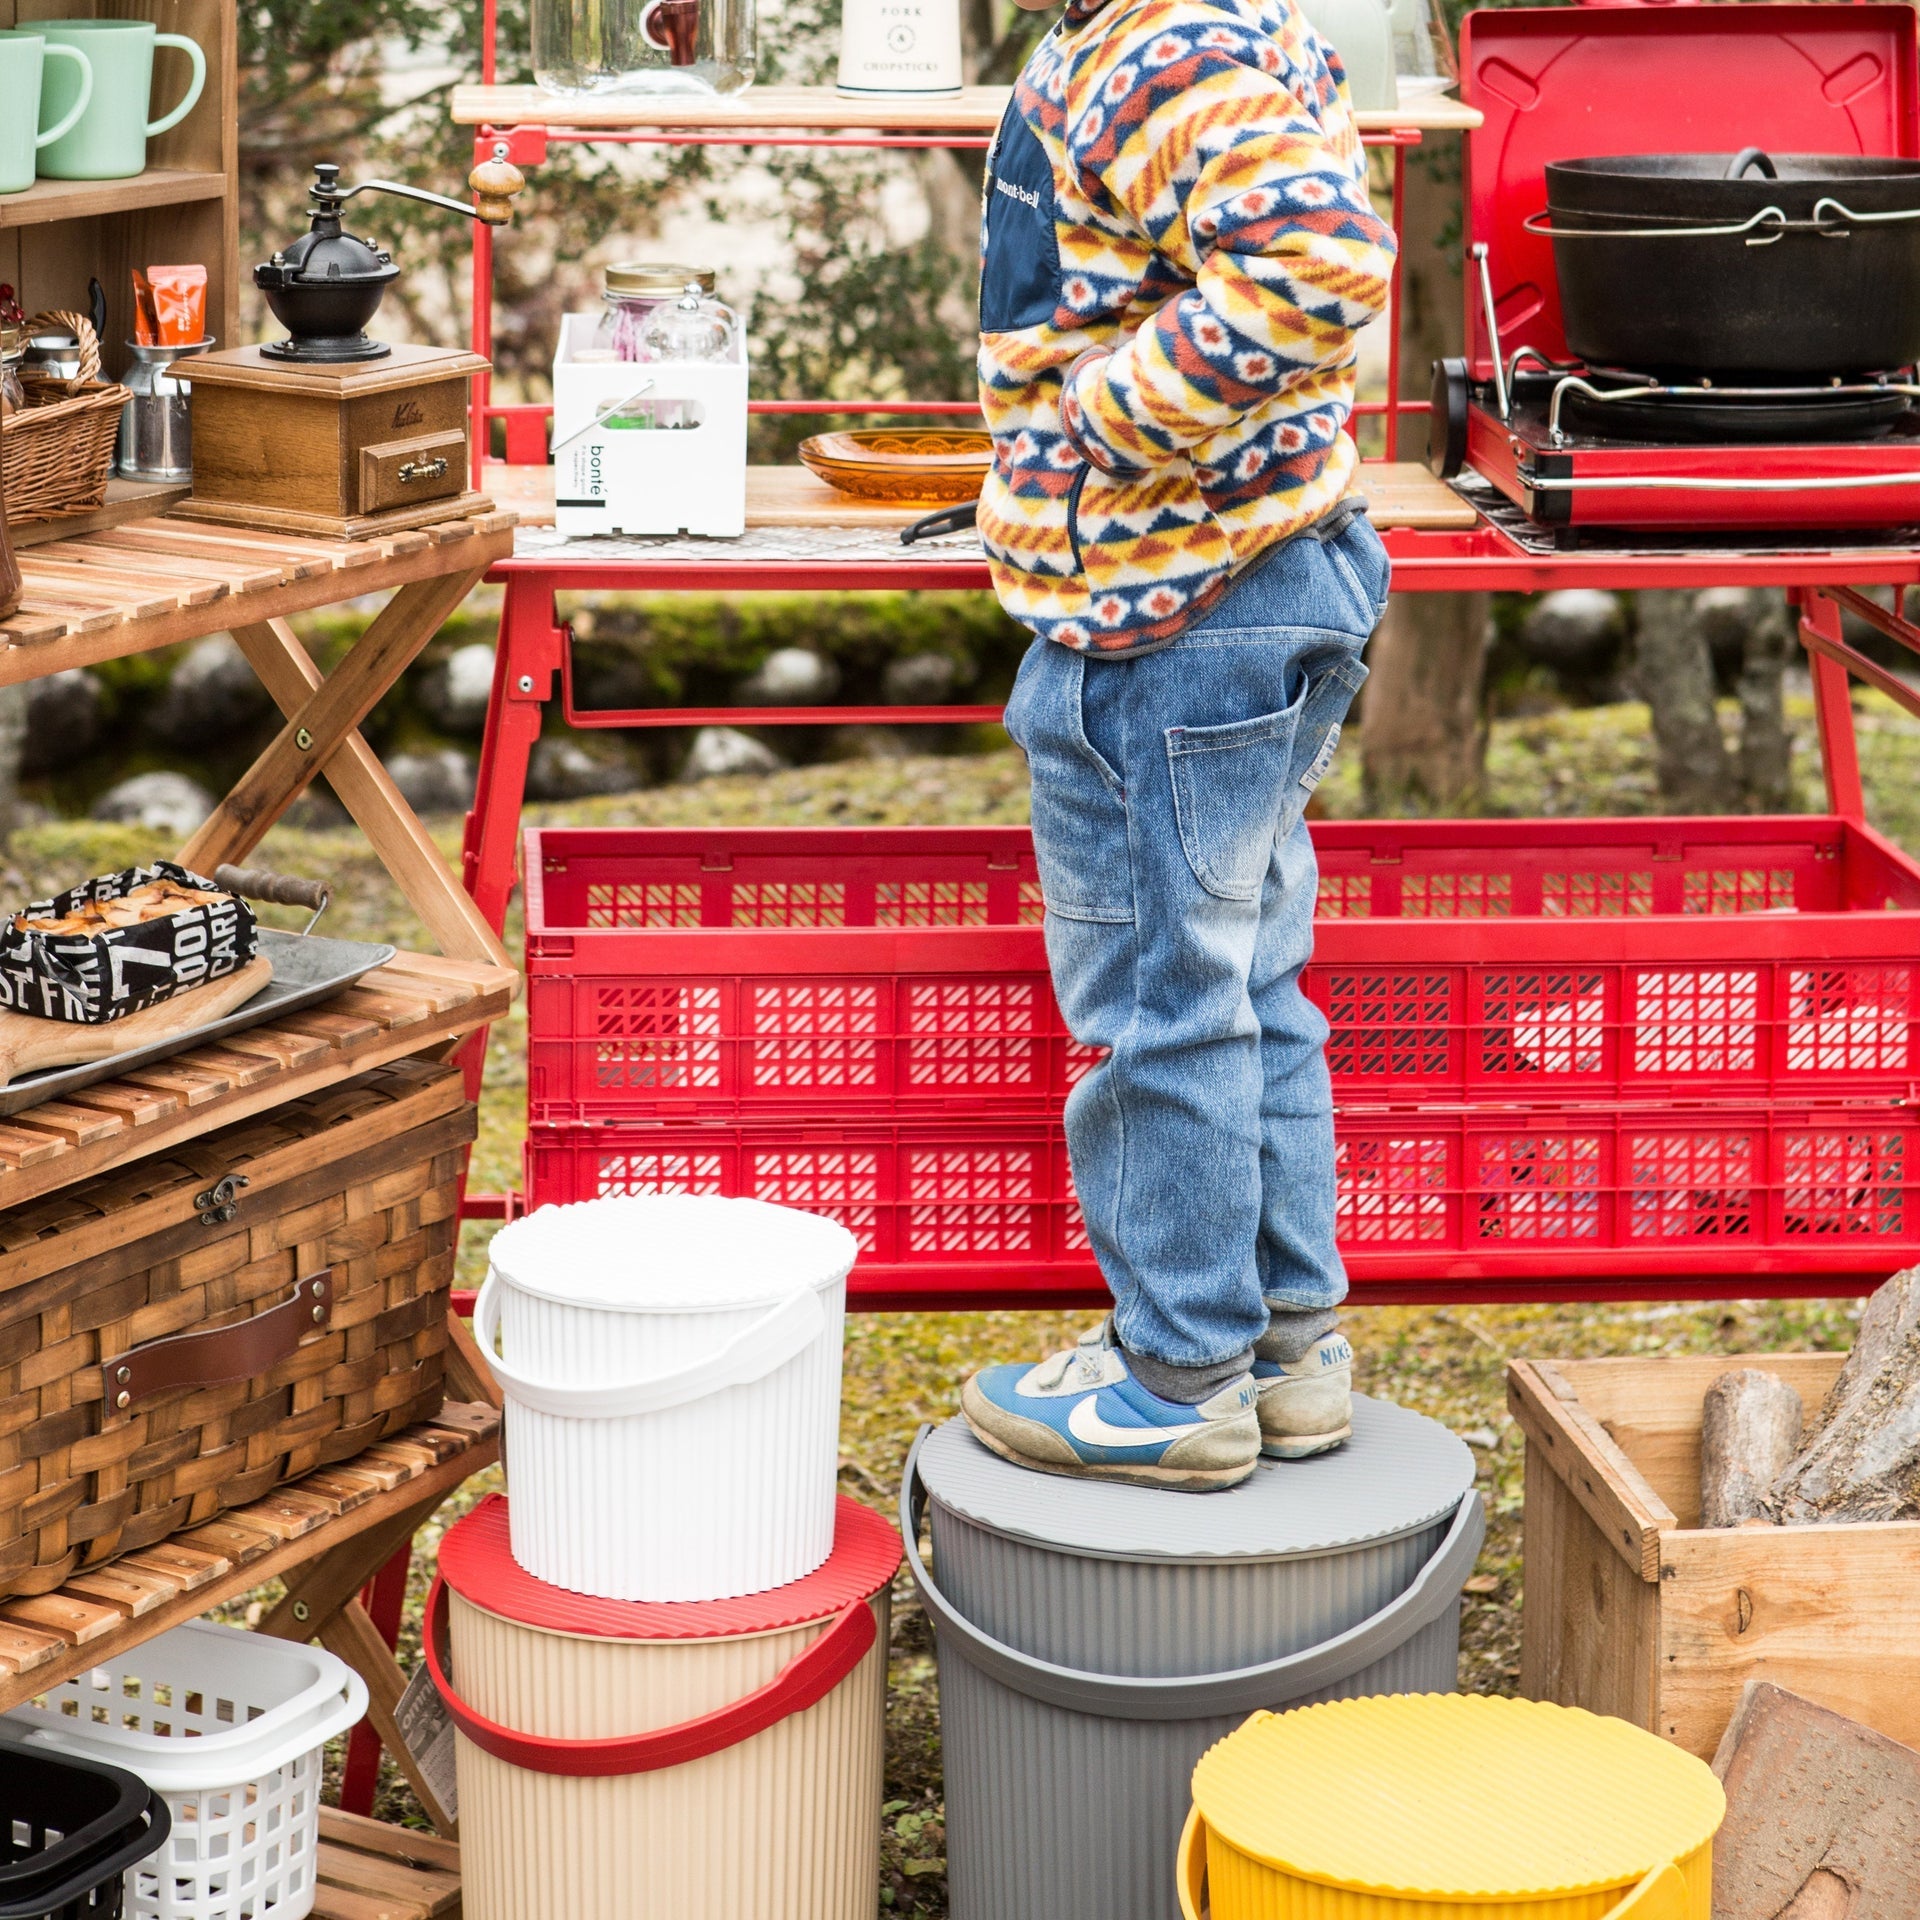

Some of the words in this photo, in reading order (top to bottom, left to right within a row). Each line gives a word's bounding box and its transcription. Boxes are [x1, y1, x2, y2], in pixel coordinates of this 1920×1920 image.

[863, 61, 939, 72] CHOPSTICKS
[590, 445, 608, 495] bonté
[1319, 1341, 1351, 1367] NIKE
